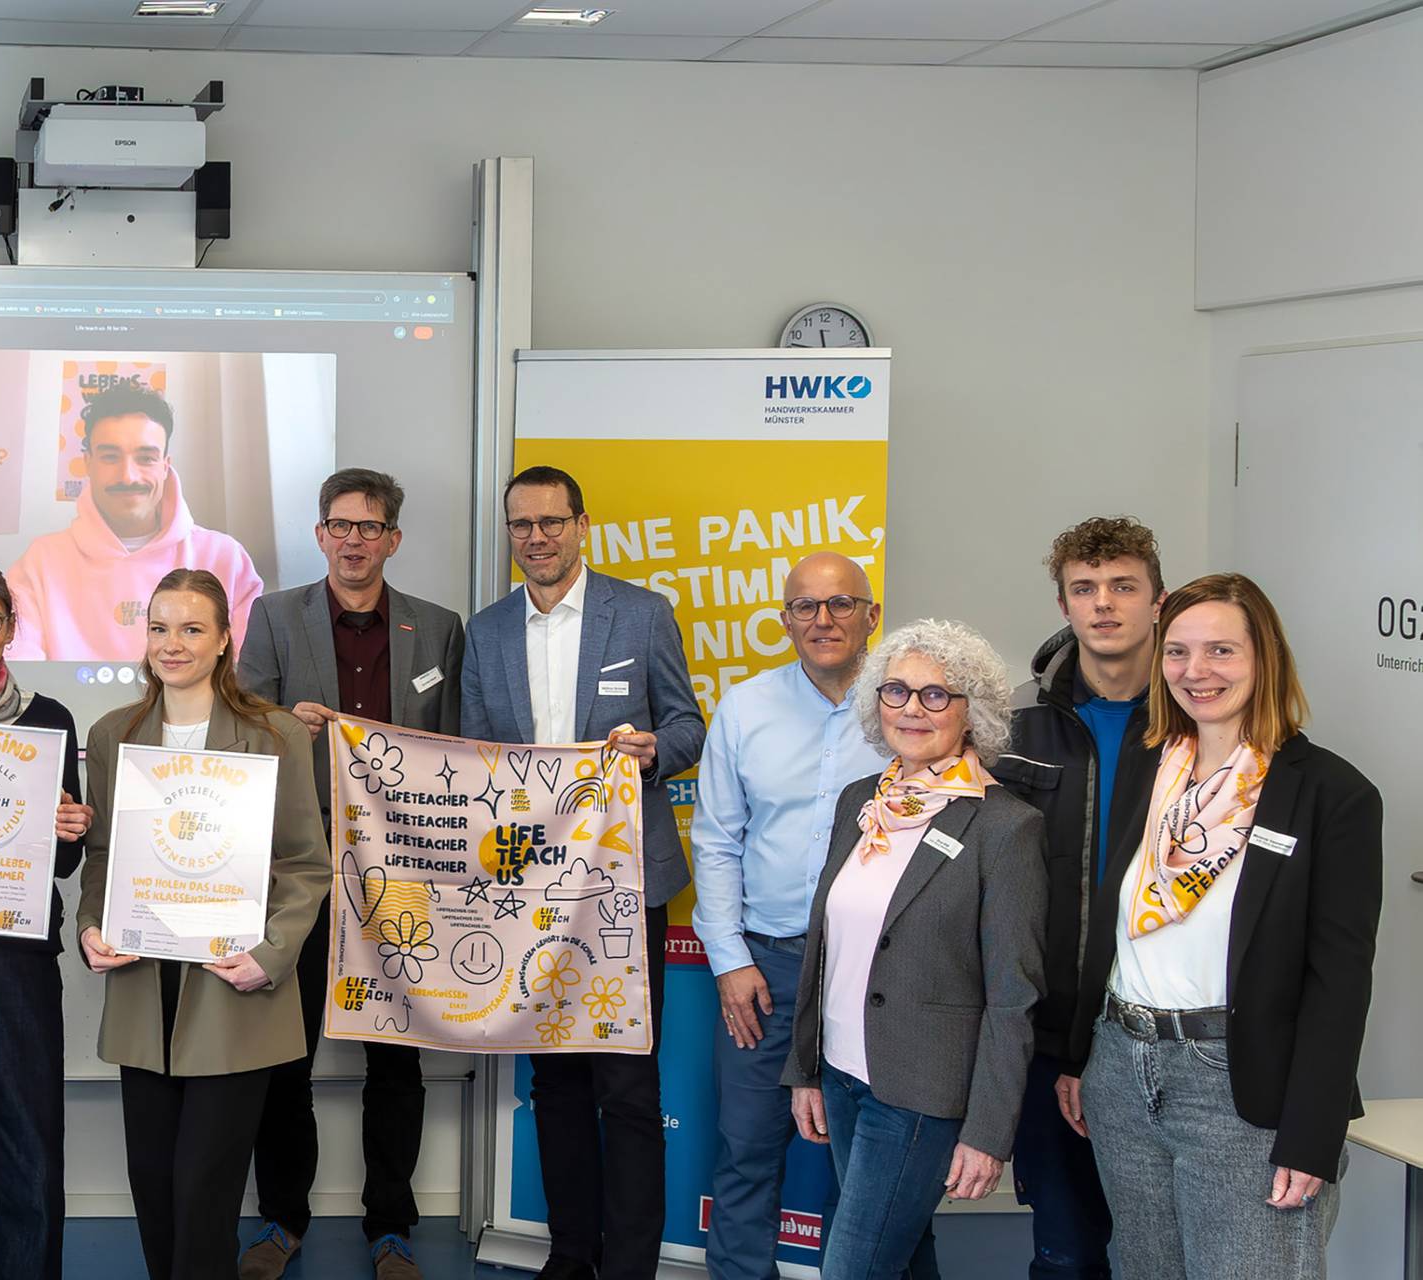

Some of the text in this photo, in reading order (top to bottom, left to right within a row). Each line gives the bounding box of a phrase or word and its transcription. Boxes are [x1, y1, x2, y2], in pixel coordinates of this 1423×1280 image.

[115, 139, 137, 147] EPSON
[804, 318, 812, 327] 11
[819, 313, 831, 323] 12
[791, 330, 802, 340] 10
[849, 330, 856, 340] 2
[765, 376, 846, 399] HWK
[764, 406, 854, 414] HANDWERKSKAMMER
[764, 415, 805, 424] MÜNSTER
[699, 494, 886, 555] PANIK,
[693, 606, 792, 661] NIC
[180, 811, 208, 822] LIFE
[180, 821, 222, 833] TEACH
[178, 831, 195, 841] US
[495, 845, 567, 866] TEACH
[0, 857, 32, 869] LEBEN
[496, 865, 524, 886] US
[1175, 858, 1212, 889] LIFE
[1187, 846, 1238, 898] TEACH
[132, 877, 245, 895] UND HOLEN DAS LEBEN
[540, 907, 560, 915] LIFE
[540, 915, 570, 923] TEACH
[539, 923, 551, 931] US
[346, 977, 378, 989] LIFE
[346, 988, 393, 1003] TEACH
[344, 1001, 364, 1011] US
